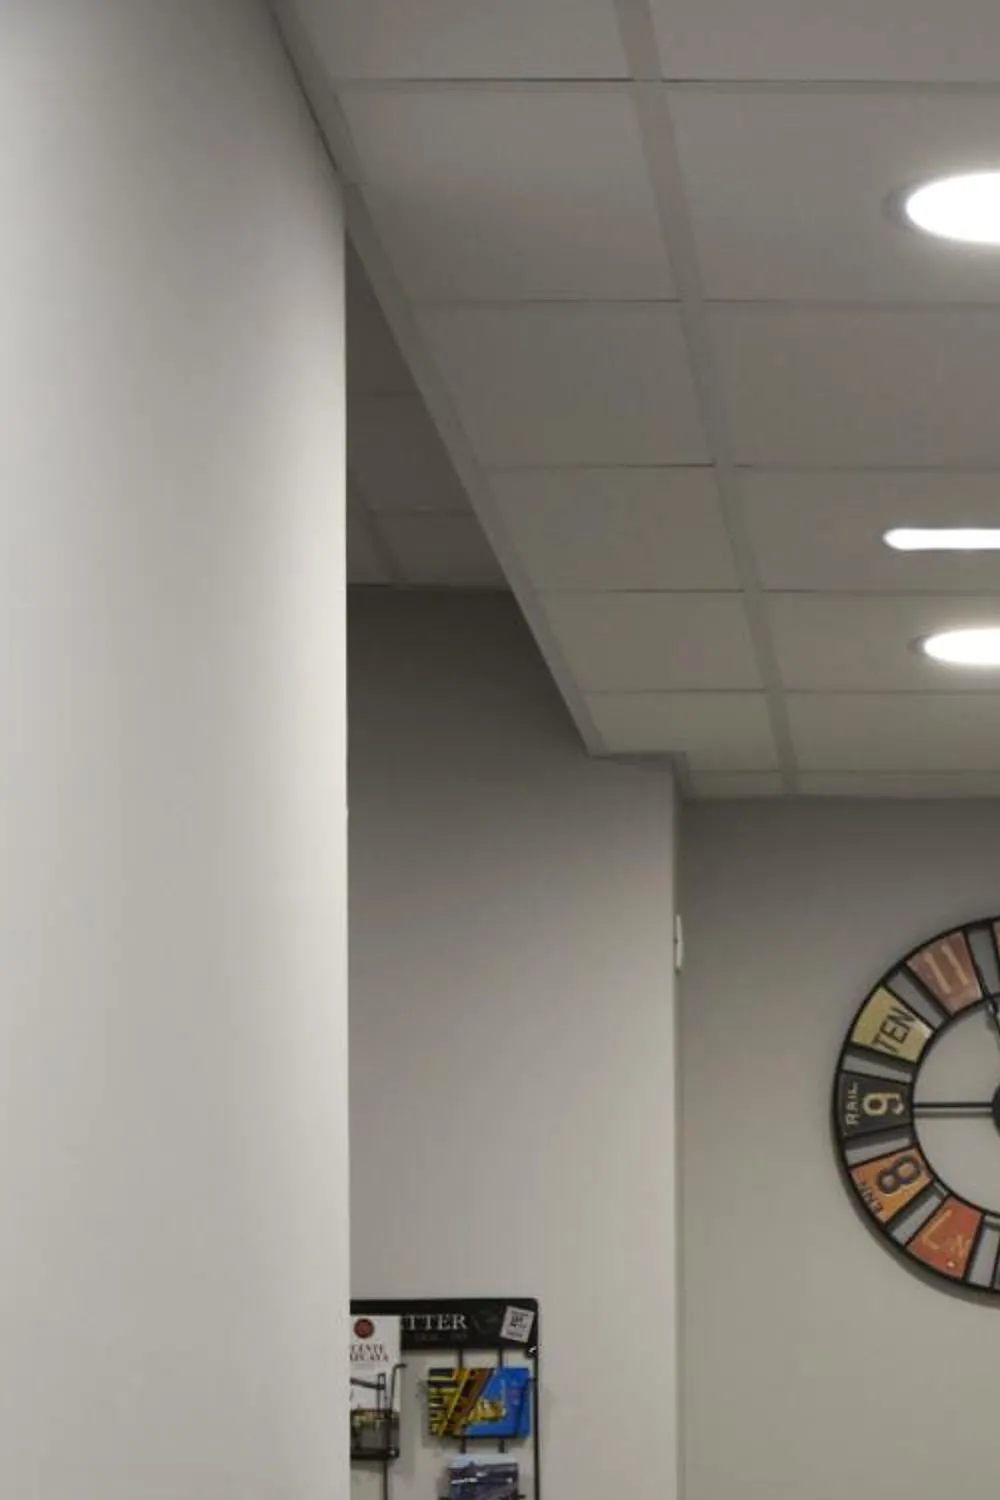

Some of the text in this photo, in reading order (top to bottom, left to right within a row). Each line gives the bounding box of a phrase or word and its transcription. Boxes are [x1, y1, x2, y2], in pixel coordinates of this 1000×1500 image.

[922, 939, 970, 995] 11
[872, 1005, 917, 1053] TEN
[846, 1080, 860, 1126] RAIL
[863, 1090, 905, 1116] 9
[877, 1156, 920, 1194] 8
[400, 1312, 469, 1332] TTER
